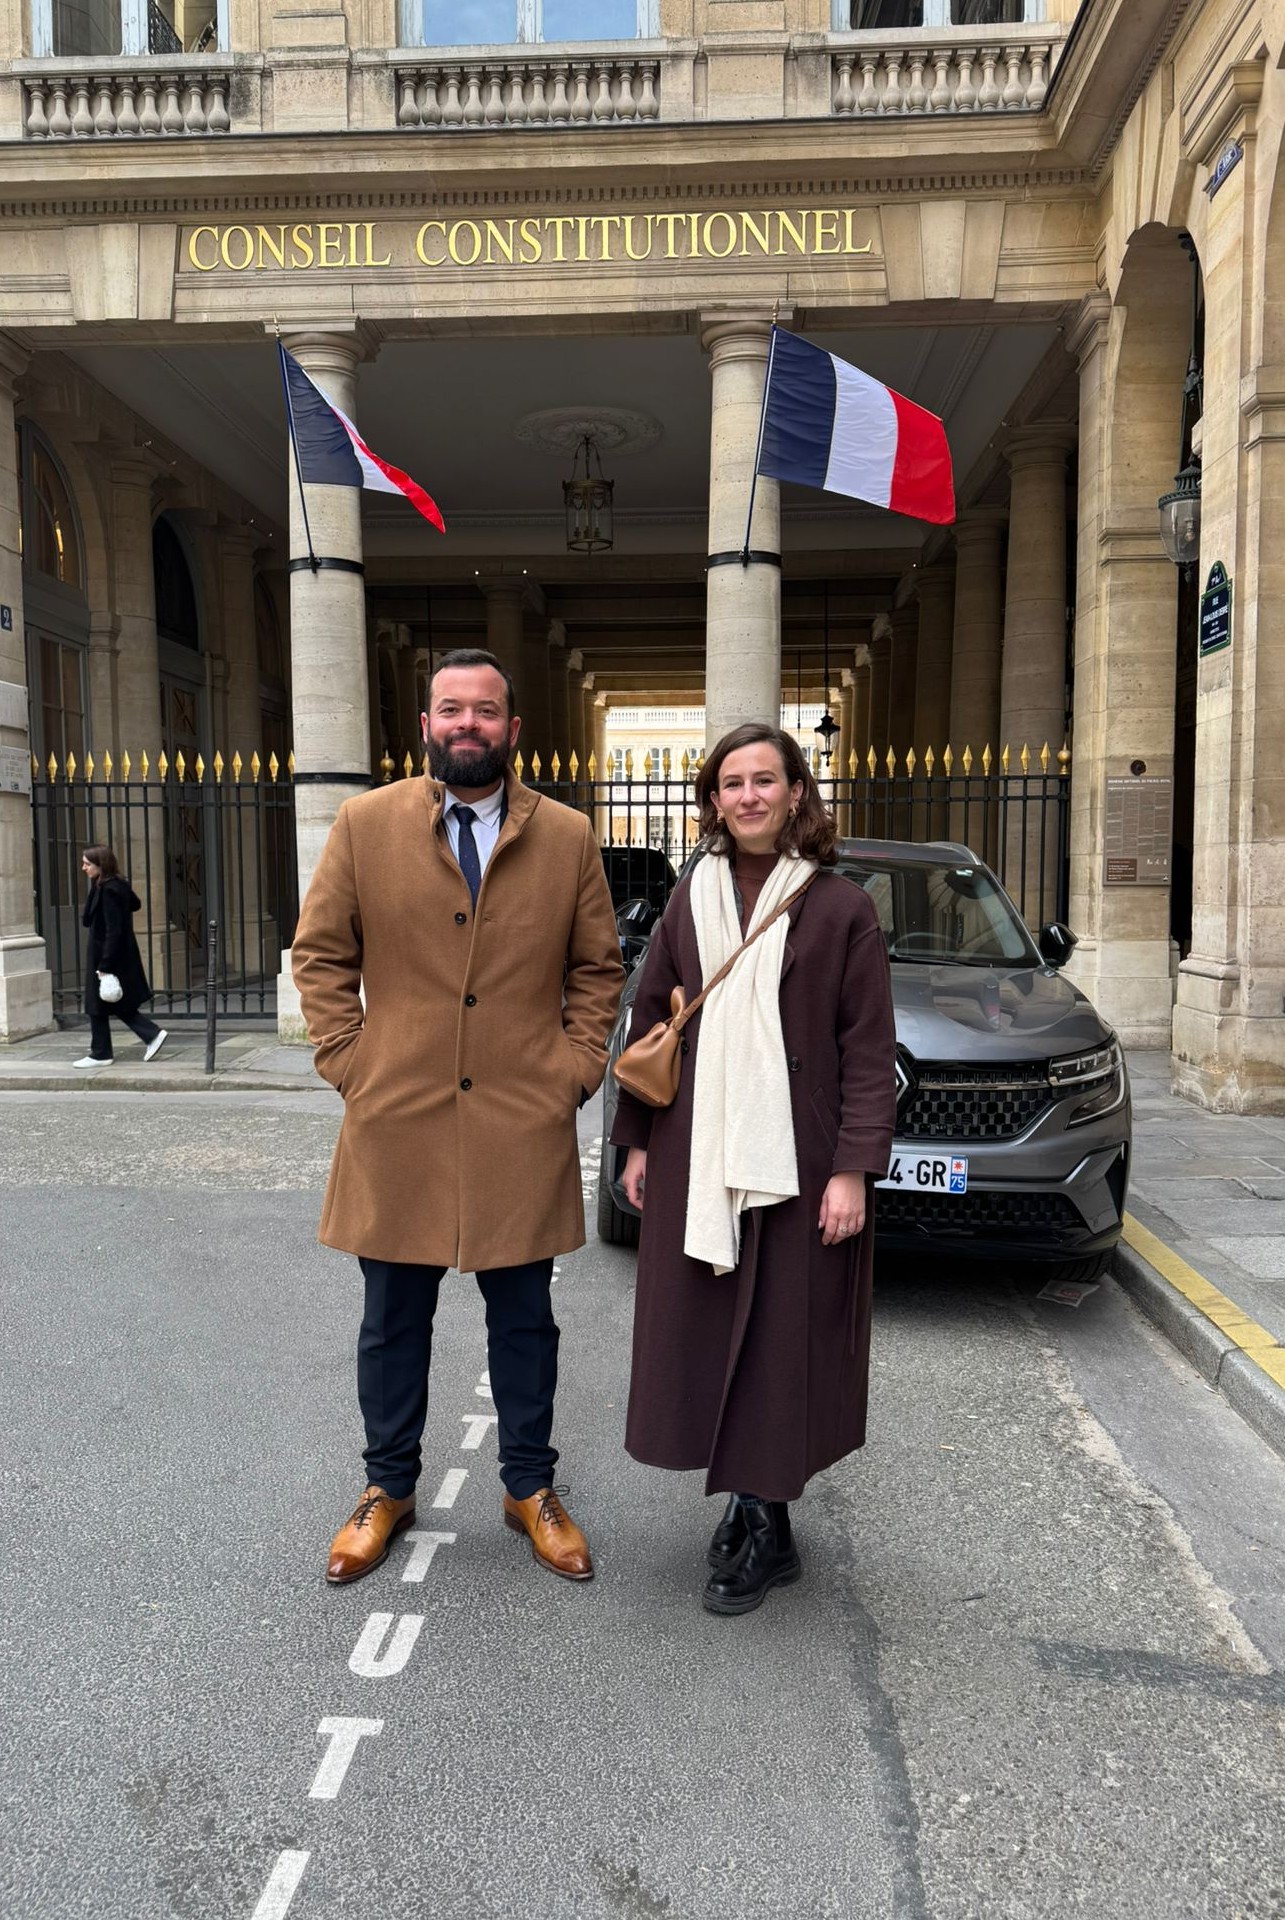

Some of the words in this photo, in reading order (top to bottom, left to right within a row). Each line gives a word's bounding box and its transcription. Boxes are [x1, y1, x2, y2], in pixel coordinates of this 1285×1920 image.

[187, 223, 392, 270] CONSEIL
[416, 209, 873, 266] CONSTITUTIONNEL
[3, 608, 11, 628] 2
[950, 1175, 965, 1189] 75
